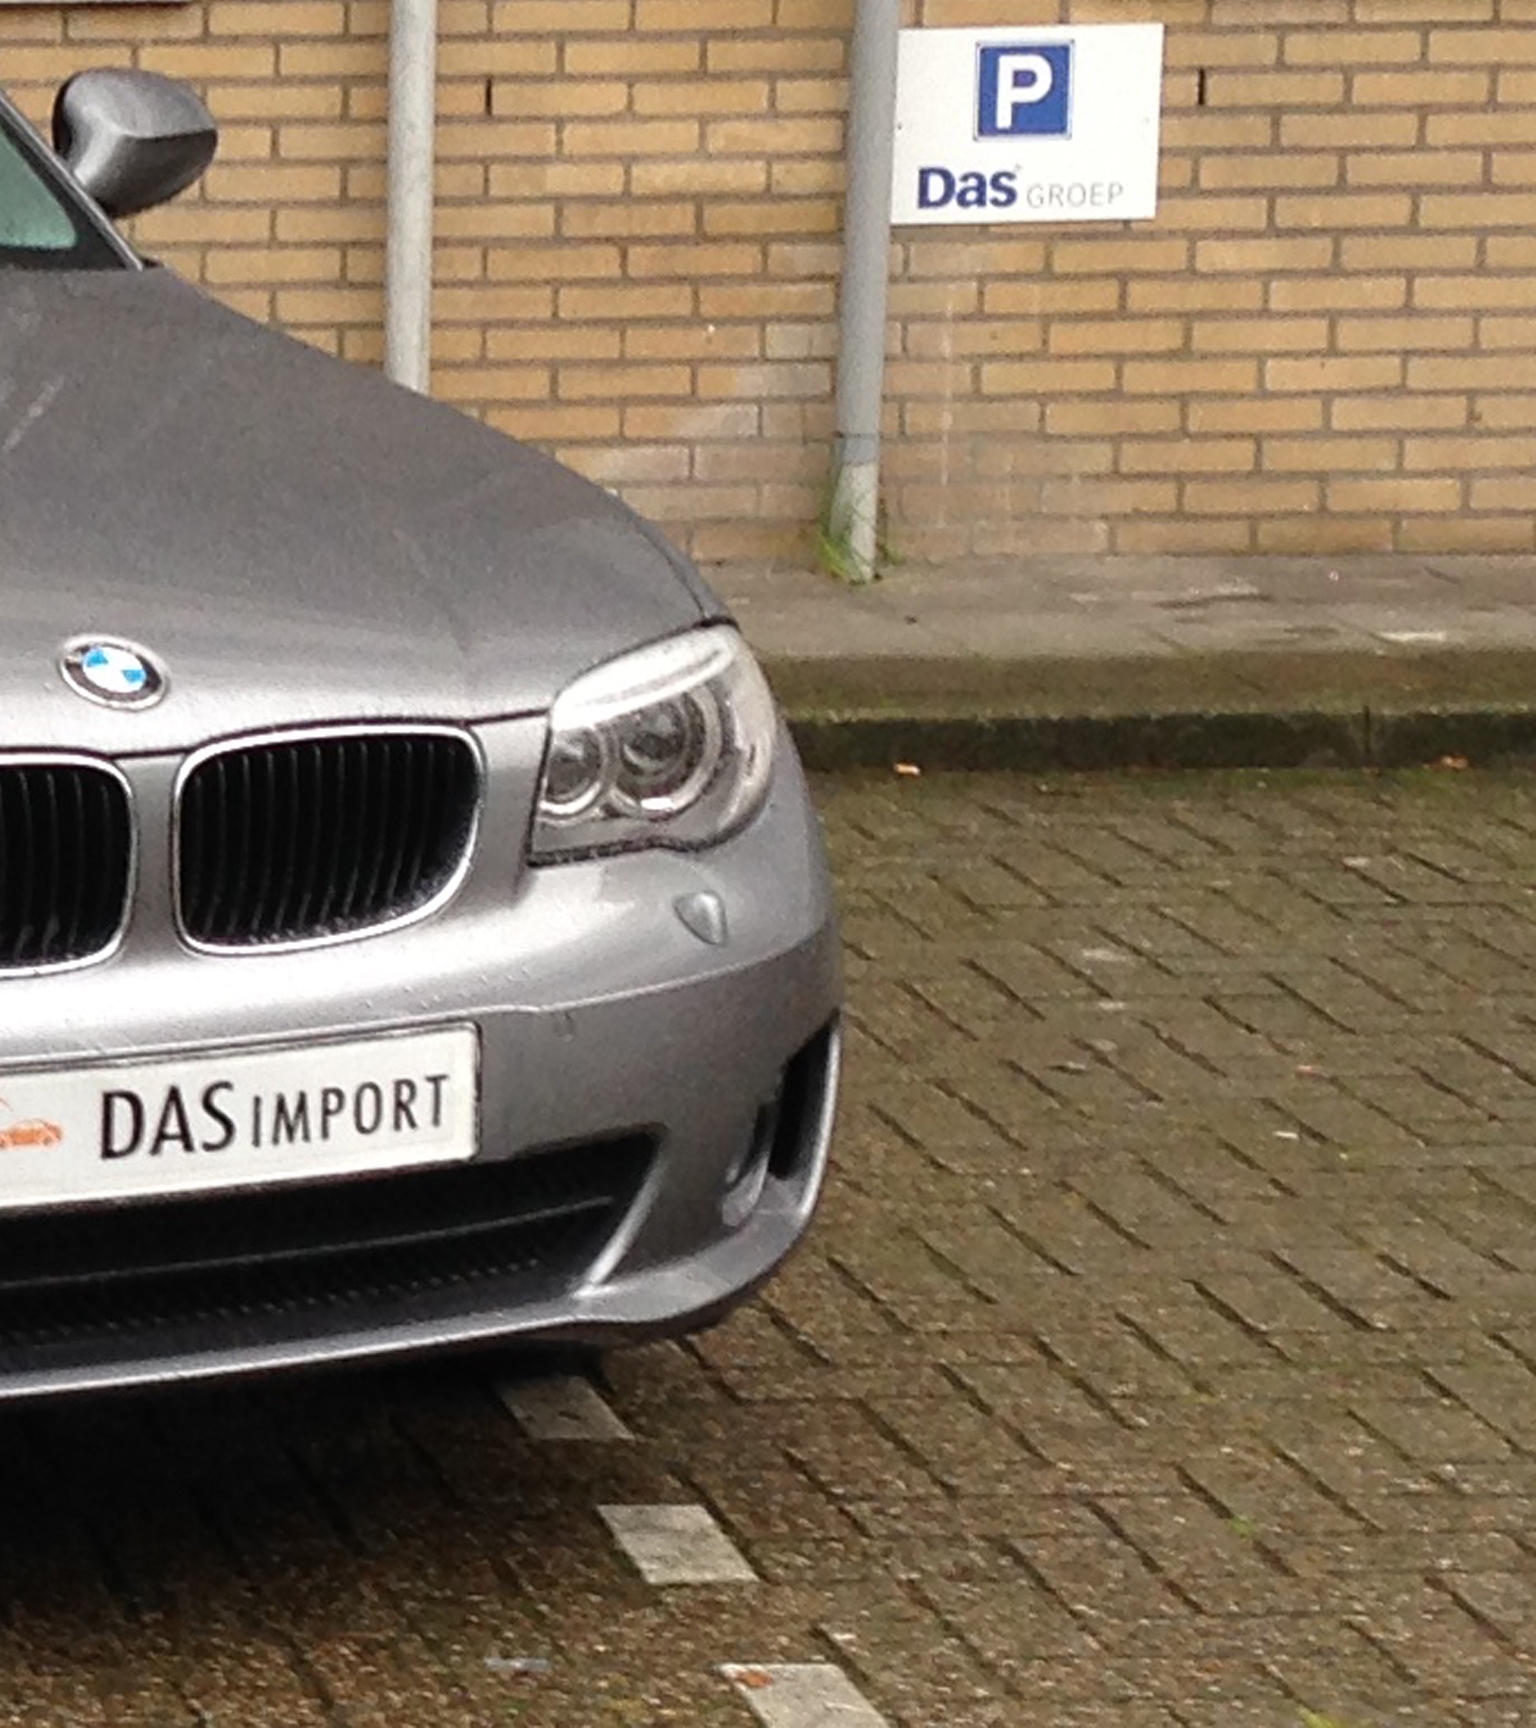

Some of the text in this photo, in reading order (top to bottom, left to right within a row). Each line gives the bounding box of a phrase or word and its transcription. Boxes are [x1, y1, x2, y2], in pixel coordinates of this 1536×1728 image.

[995, 53, 1054, 130] P
[918, 165, 1125, 210] Das GROEP
[99, 1074, 451, 1161] DAS IMPORT
